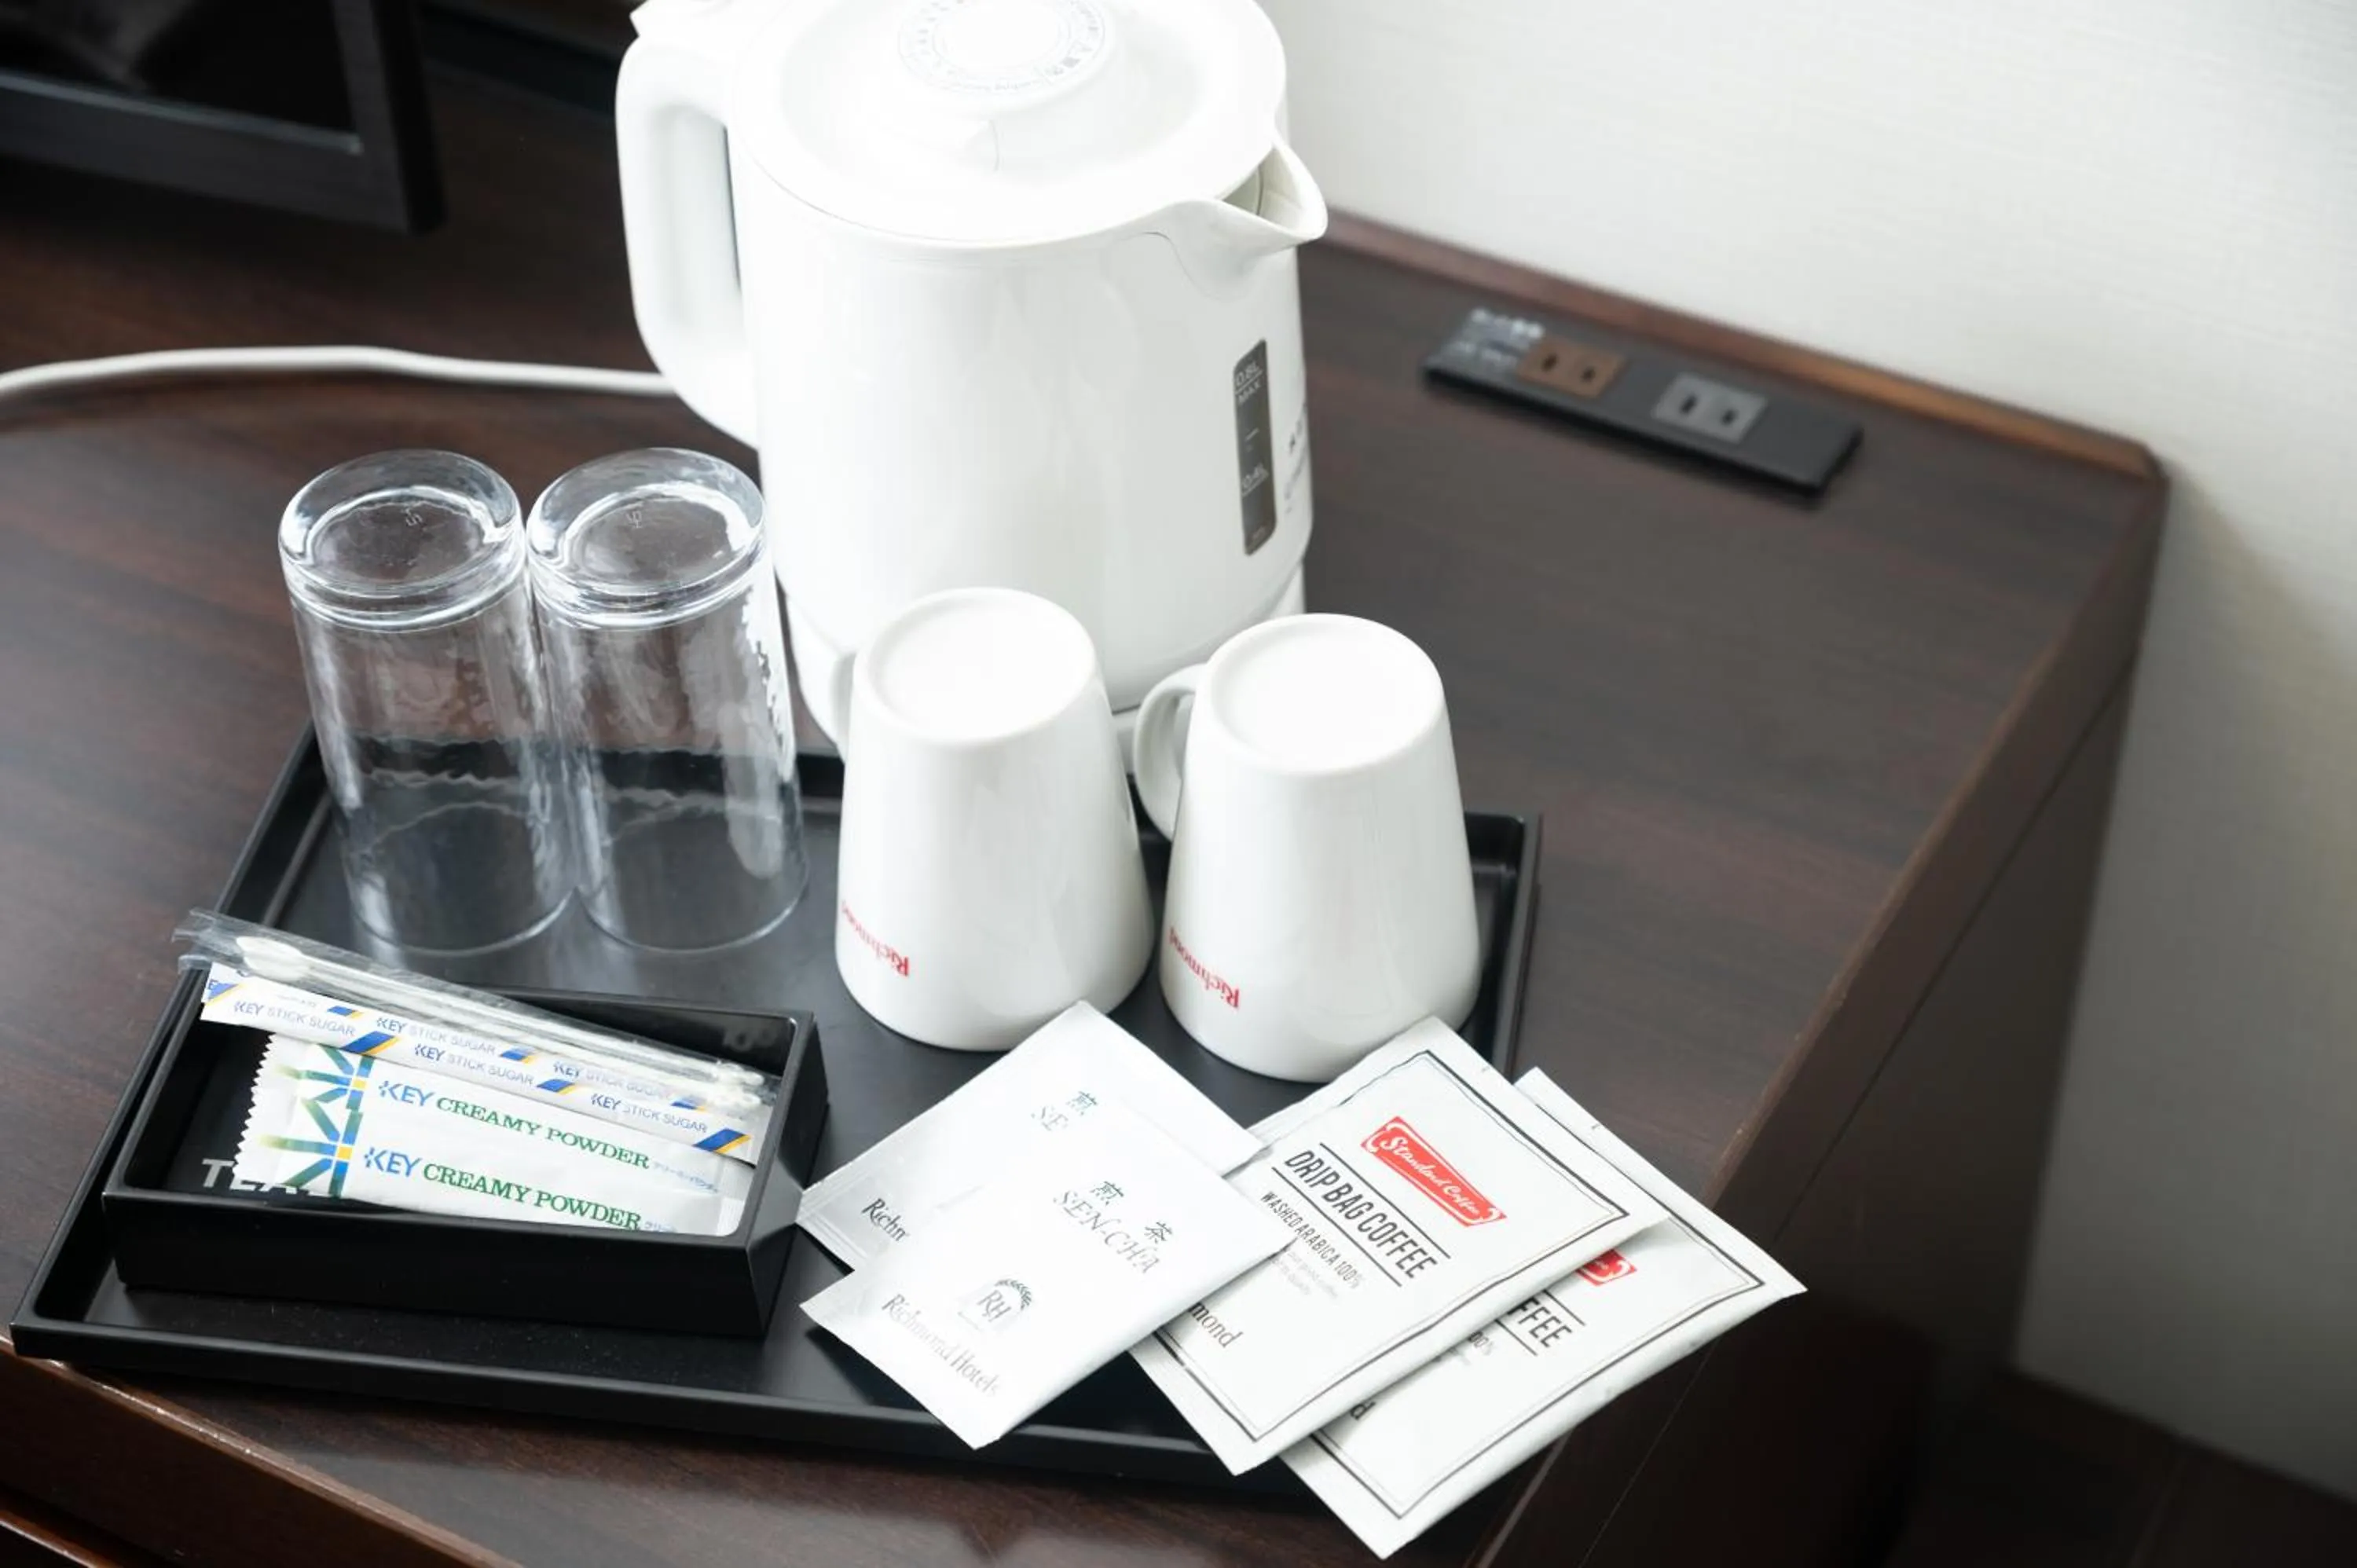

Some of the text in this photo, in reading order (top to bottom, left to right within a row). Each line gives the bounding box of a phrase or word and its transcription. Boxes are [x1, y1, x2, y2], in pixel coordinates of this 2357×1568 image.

[234, 1001, 356, 1035] KEY STICK SUGAR
[376, 1017, 497, 1056] KEY STICK SUGAR
[414, 1043, 534, 1085] KEY STICK SUGAR
[379, 1080, 650, 1170] KEY CREAMY POWDER
[590, 1093, 707, 1134] KEY STICK SUGAR
[1065, 1090, 1098, 1116] 煎
[1380, 1136, 1453, 1188] Standard
[364, 1146, 423, 1178] KEY
[423, 1163, 533, 1203] CREAMY
[534, 1189, 641, 1231] POWDER
[1260, 1190, 1304, 1229] WASHED
[1295, 1223, 1342, 1267] ARABICA
[1284, 1149, 1342, 1189] DRIP
[1321, 1181, 1376, 1222] BAG
[1356, 1211, 1439, 1280] COFFEE
[882, 1293, 960, 1361] Richmond
[1187, 1300, 1244, 1349] mond
[1466, 1329, 1497, 1357] 00%
[1506, 1295, 1574, 1348] FFEE
